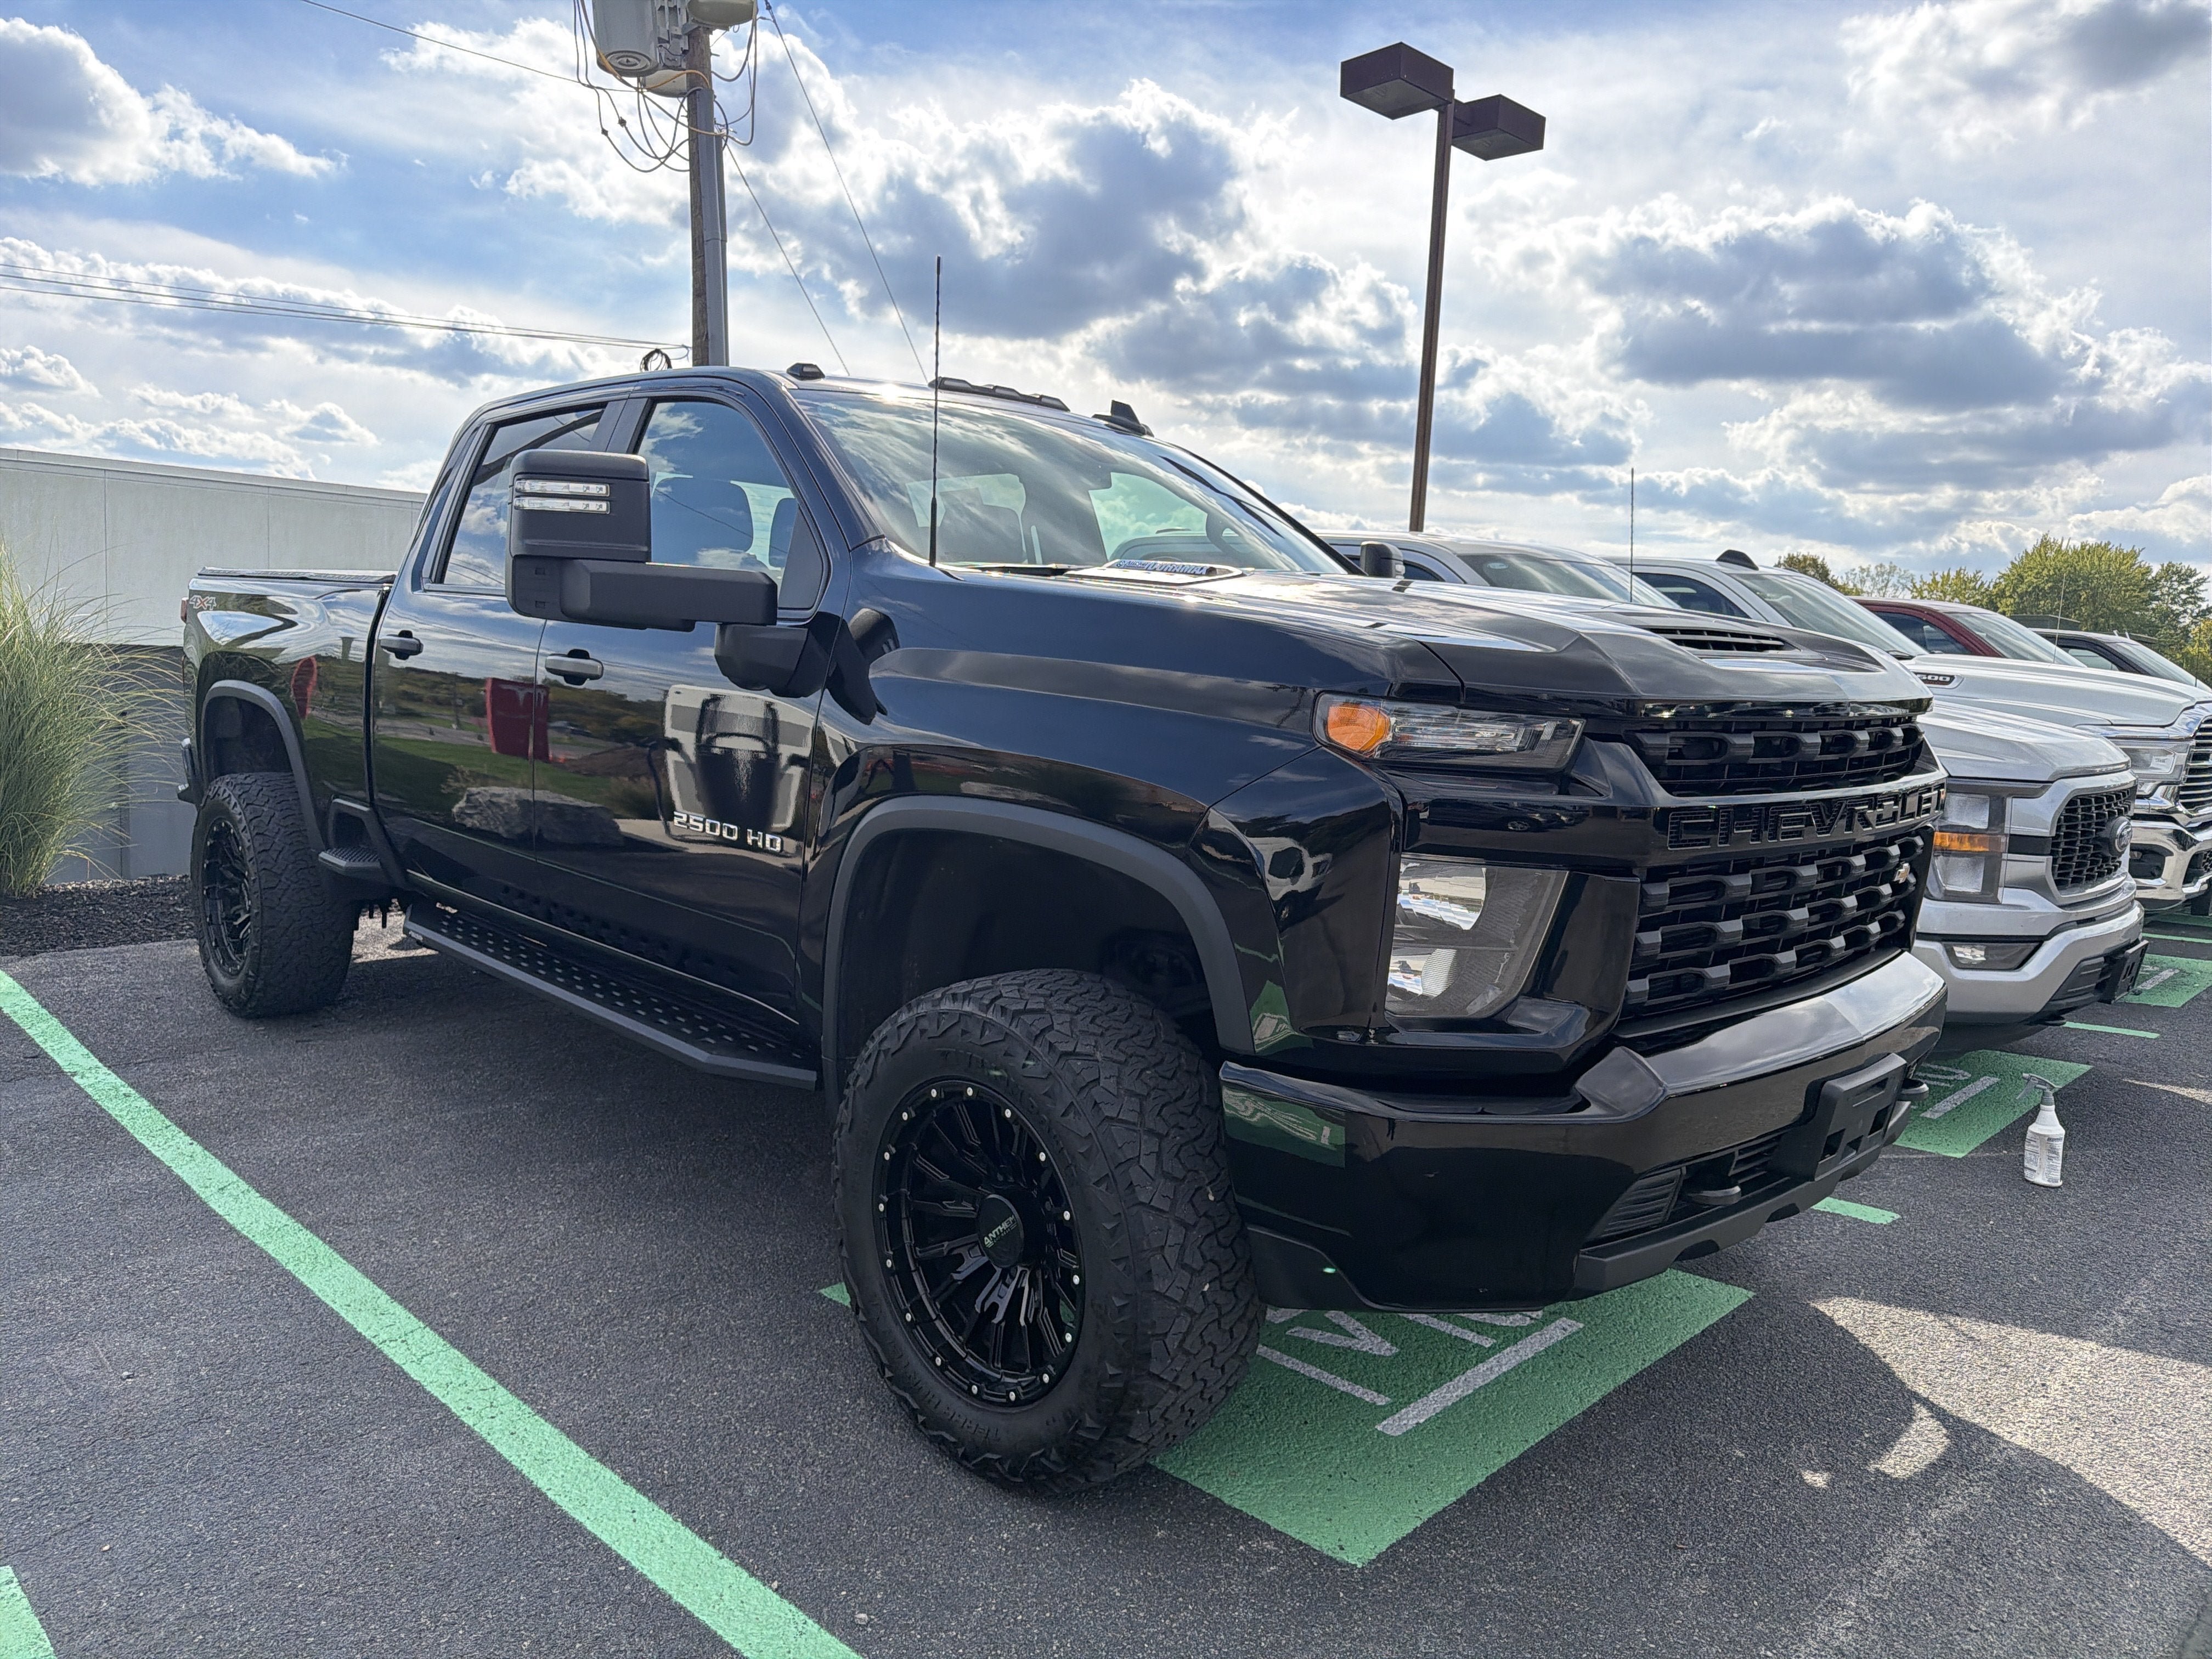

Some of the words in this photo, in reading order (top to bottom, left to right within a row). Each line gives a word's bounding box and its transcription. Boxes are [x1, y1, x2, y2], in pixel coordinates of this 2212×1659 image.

[1148, 562, 1207, 575] DURAMAX
[674, 811, 738, 842] 2500
[747, 829, 783, 853] HD
[1668, 782, 1945, 850] CHEVROLET
[984, 1214, 1017, 1245] ANTHEM
